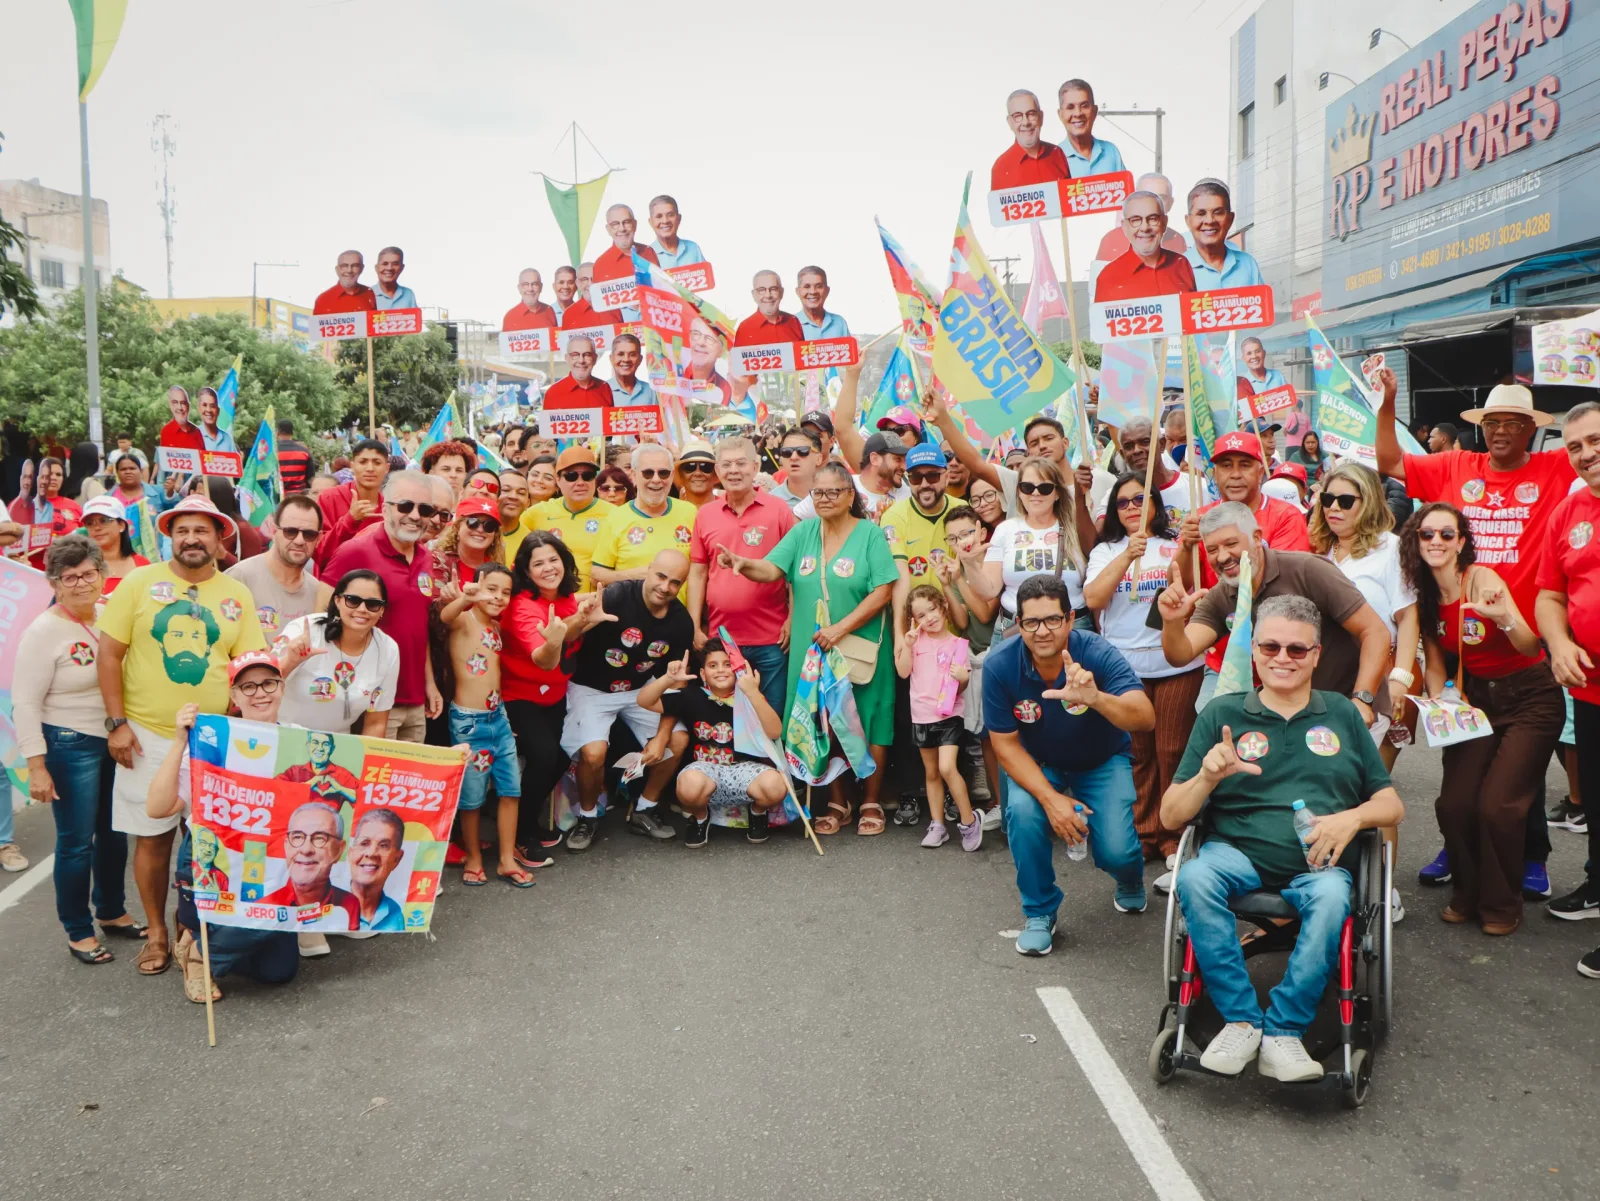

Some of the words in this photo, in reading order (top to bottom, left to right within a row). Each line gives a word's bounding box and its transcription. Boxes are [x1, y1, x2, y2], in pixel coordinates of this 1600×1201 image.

[1380, 51, 1452, 135] REAL
[1458, 0, 1573, 92] PEÇAS
[1378, 158, 1397, 210] E
[1401, 75, 1561, 201] MOTORES
[1067, 180, 1085, 197] ZÉ
[1084, 181, 1124, 194] RAIMUNDO
[1485, 168, 1541, 207] CAMINHÕES
[1000, 191, 1045, 205] WALDENOR
[1067, 190, 1126, 213] 13222
[1329, 165, 1373, 240] RP
[1001, 200, 1047, 221] 1322
[1445, 230, 1491, 261] 3421-9195
[1497, 212, 1552, 246] 3028-0288
[600, 281, 637, 294] WALDENO
[602, 288, 640, 307] 1322
[1190, 293, 1213, 312] ZÉ
[1212, 295, 1261, 310] RAIMUNDO
[373, 311, 387, 323] ZÉ
[1104, 303, 1162, 319] WALDENOR
[1191, 305, 1263, 330] 13222
[318, 317, 355, 326] WALDENOR
[373, 320, 416, 334] 13222
[647, 307, 684, 333] 1322
[1106, 314, 1164, 338] 1322
[319, 324, 356, 338] 1322
[508, 332, 540, 342] WALDENOR
[509, 340, 541, 353] 1322
[741, 349, 781, 359] WALDENOR
[801, 341, 816, 355] ZÉ
[801, 351, 851, 367] 13222
[940, 294, 1031, 416] BRASIL
[743, 356, 783, 371] 1322
[1255, 395, 1292, 414] 13222
[1321, 393, 1368, 424] WALDENOR
[549, 413, 590, 422] WALDENOR
[610, 408, 625, 420] ZÉ
[1318, 405, 1365, 438] 1322
[550, 421, 591, 435] 1322
[609, 418, 657, 433] 13222
[168, 458, 193, 470] 1322
[1462, 505, 1492, 519] QUEM
[1473, 535, 1504, 549] UNCA
[233, 652, 271, 669] LULA
[364, 762, 392, 784] ZÉ
[390, 773, 447, 792] RAIMUNDO
[203, 775, 276, 808] WALDENOR
[362, 783, 444, 811] 13222
[200, 793, 272, 837] 1322
[217, 903, 234, 912] 133
[246, 906, 276, 919] JERO
[279, 908, 287, 920] 13
